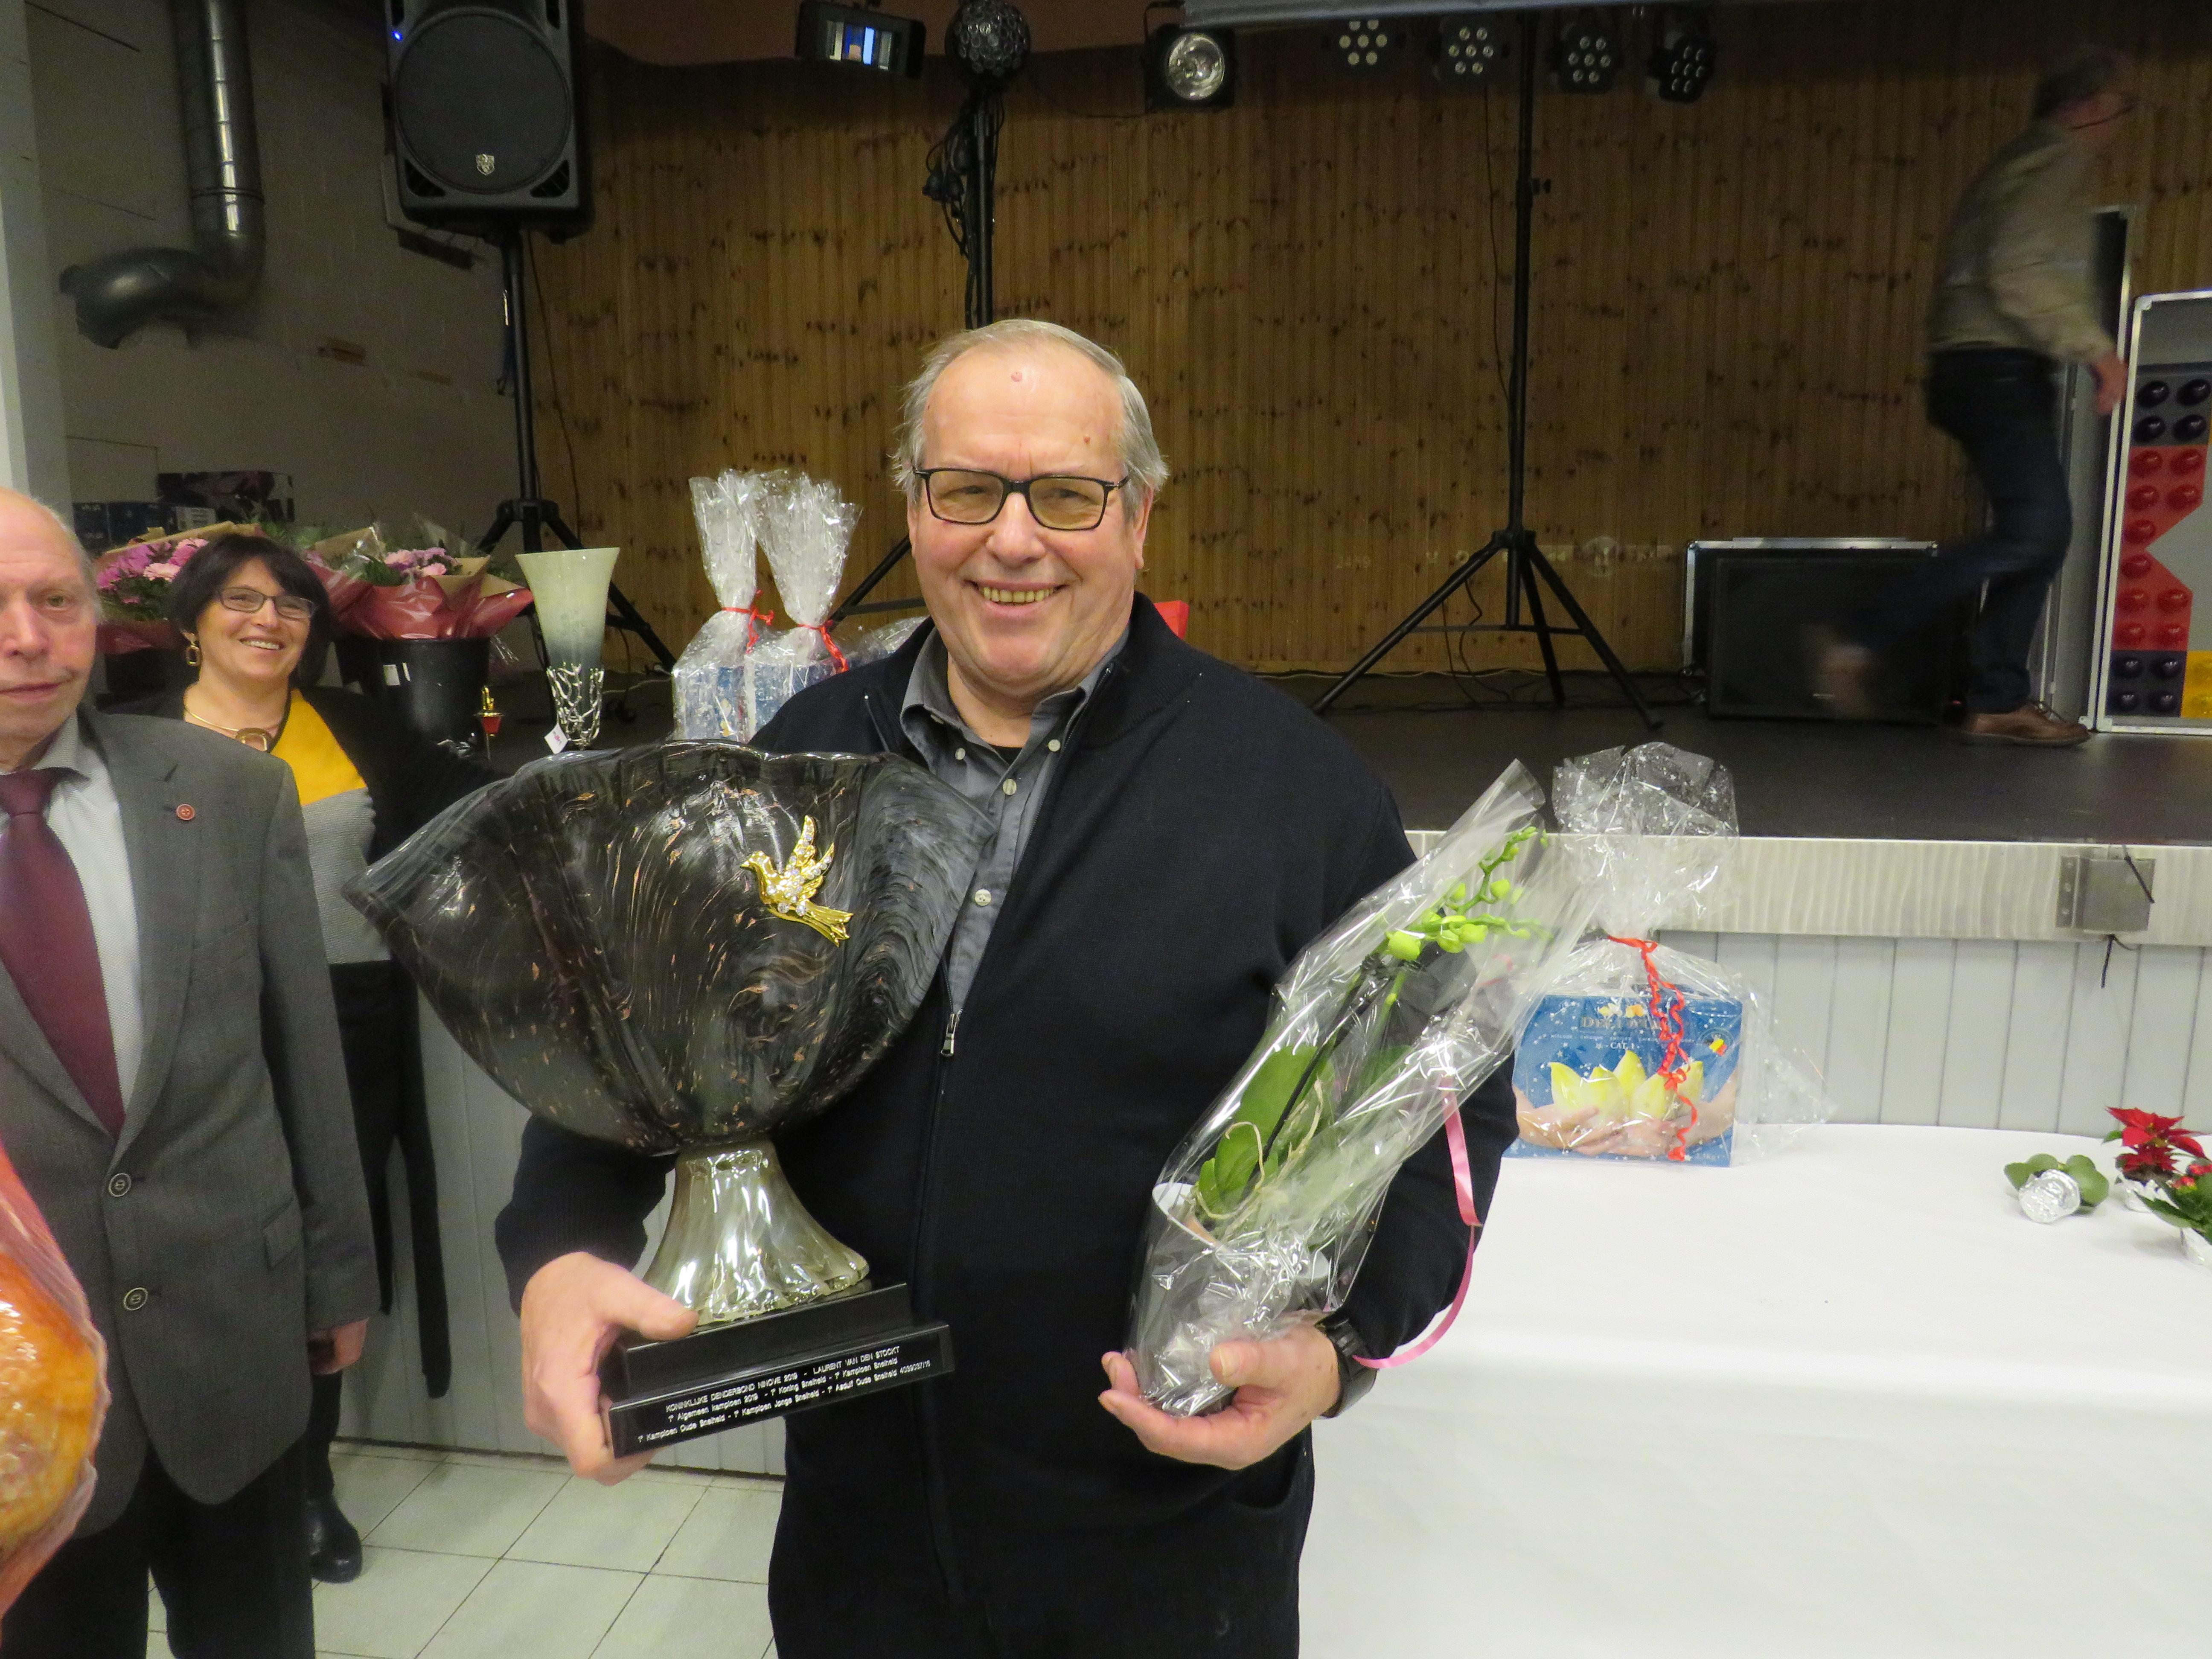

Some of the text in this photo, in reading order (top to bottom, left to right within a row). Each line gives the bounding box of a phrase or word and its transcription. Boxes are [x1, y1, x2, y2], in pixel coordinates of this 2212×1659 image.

[646, 1427, 678, 1441] Kampioen
[680, 1422, 697, 1433] Oude
[699, 1414, 726, 1428] Snelheid
[742, 1403, 772, 1416] Kampioen
[774, 1397, 793, 1408] Jonge
[795, 1389, 820, 1403] Snelheid
[856, 1376, 872, 1386] Oude
[873, 1369, 898, 1382] Snelheid
[666, 1395, 708, 1413] KONINKLIJKE
[710, 1383, 755, 1401] DENDERBOND
[758, 1376, 782, 1389] NINOVE
[813, 1361, 842, 1374] LAURENT
[845, 1357, 858, 1366] VAN
[860, 1353, 873, 1362] DEN
[875, 1345, 900, 1359] STOCKT
[677, 1407, 709, 1421] Algemeen
[711, 1398, 742, 1411] kampioen
[778, 1383, 799, 1394] Koning
[801, 1376, 827, 1388] Snelheid
[842, 1365, 872, 1378] Kampioen
[873, 1356, 898, 1370] Snelheid
